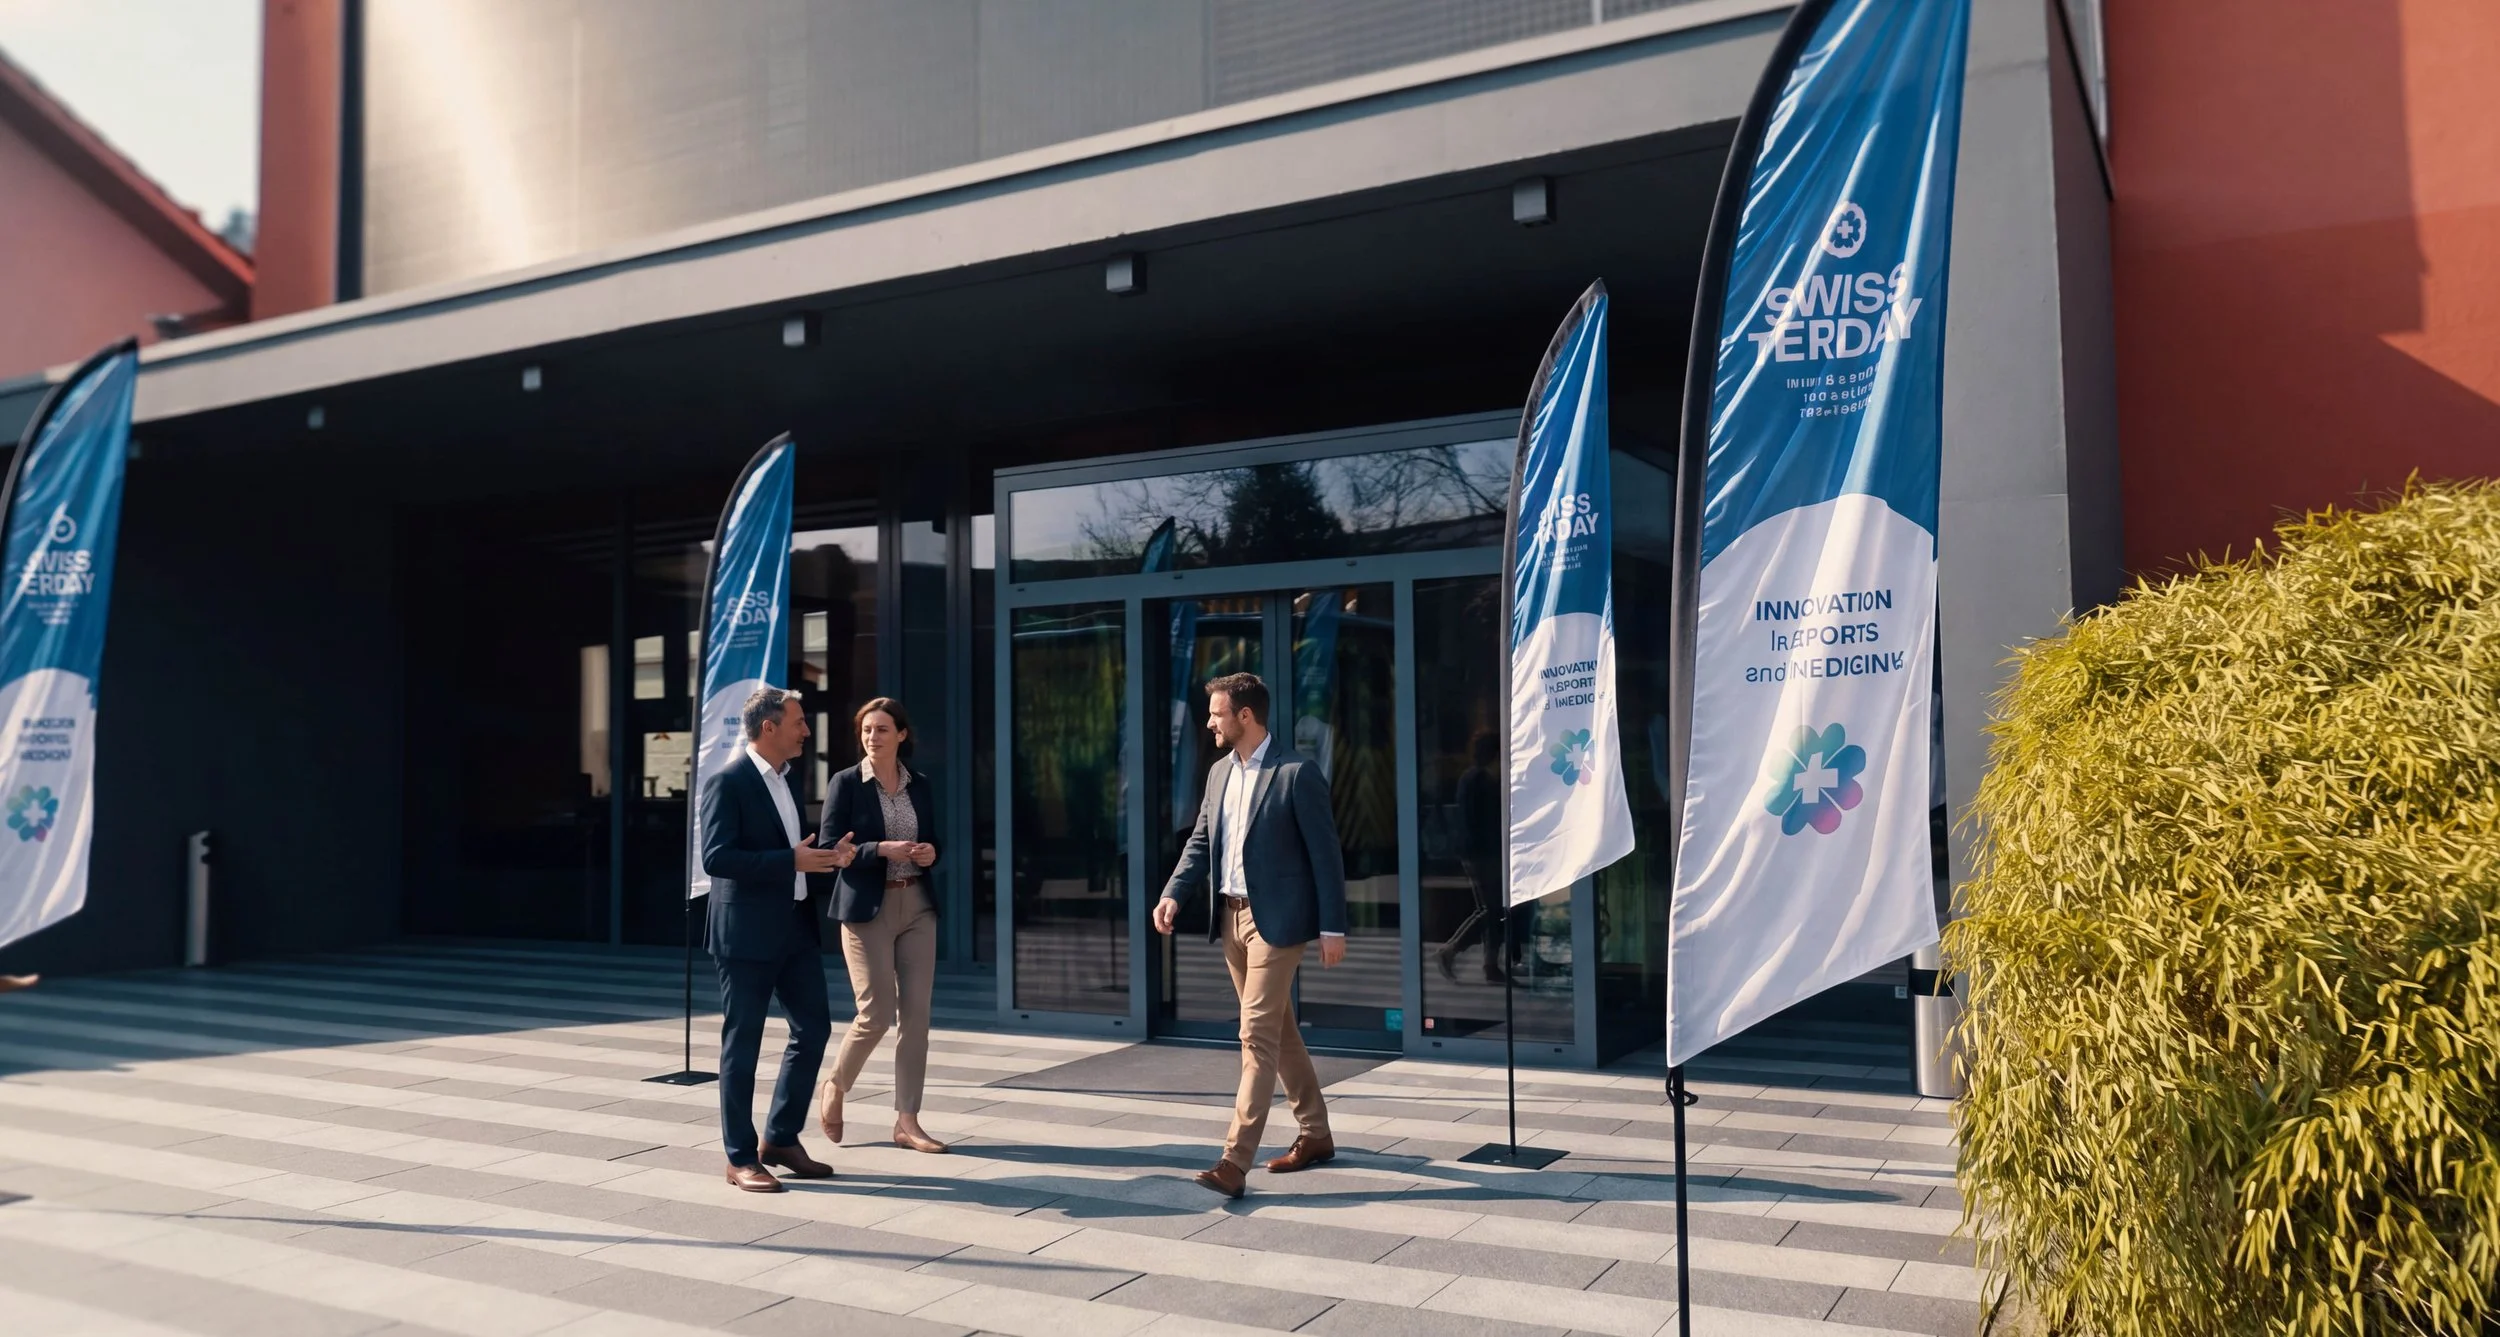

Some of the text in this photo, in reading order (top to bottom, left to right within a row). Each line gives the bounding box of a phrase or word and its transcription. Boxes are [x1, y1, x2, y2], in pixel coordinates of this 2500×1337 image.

[1765, 262, 1908, 324] SWISS
[1748, 298, 1923, 366] TERDAY
[1756, 589, 1892, 621] INNOVATION
